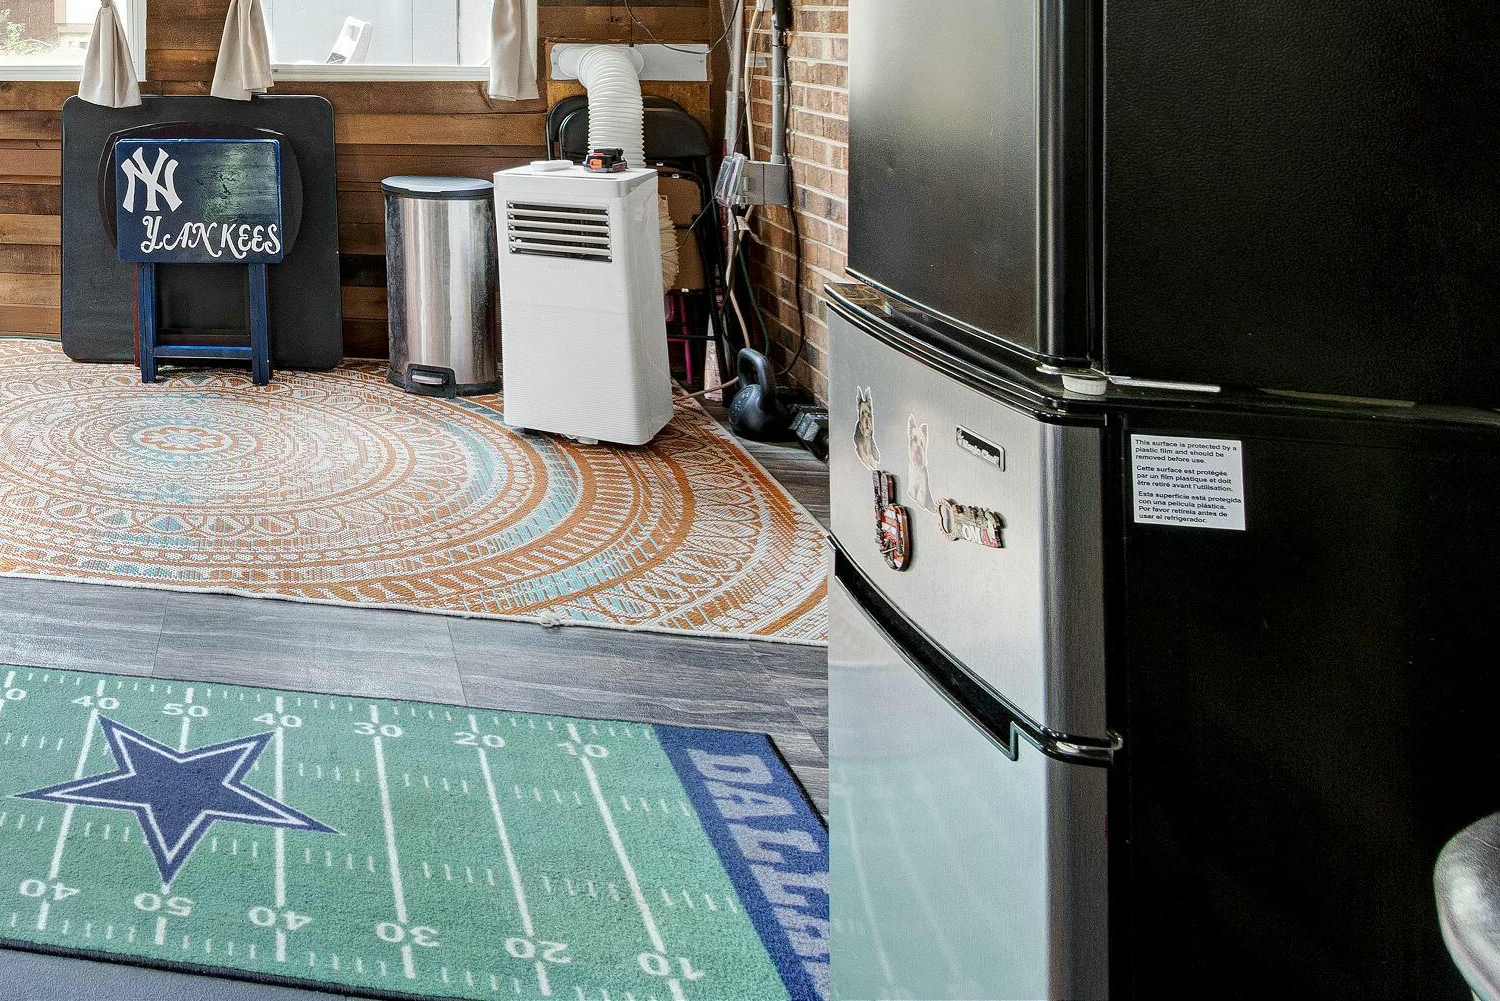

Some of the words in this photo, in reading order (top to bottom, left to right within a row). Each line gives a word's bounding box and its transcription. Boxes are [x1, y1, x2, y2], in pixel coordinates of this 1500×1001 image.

[121, 147, 183, 213] NY
[1175, 475, 1208, 483] plastique
[71, 694, 120, 711] 40
[162, 703, 209, 718] 50
[253, 713, 303, 728] 40
[353, 722, 404, 738] 30
[454, 732, 506, 749] 20
[557, 742, 609, 759] 10
[686, 748, 829, 1000] DALLA
[19, 878, 80, 900] 40
[133, 892, 195, 917] 50
[248, 905, 312, 931] 40
[376, 921, 440, 949] 30
[505, 937, 573, 965] 20
[637, 952, 705, 981] 10
